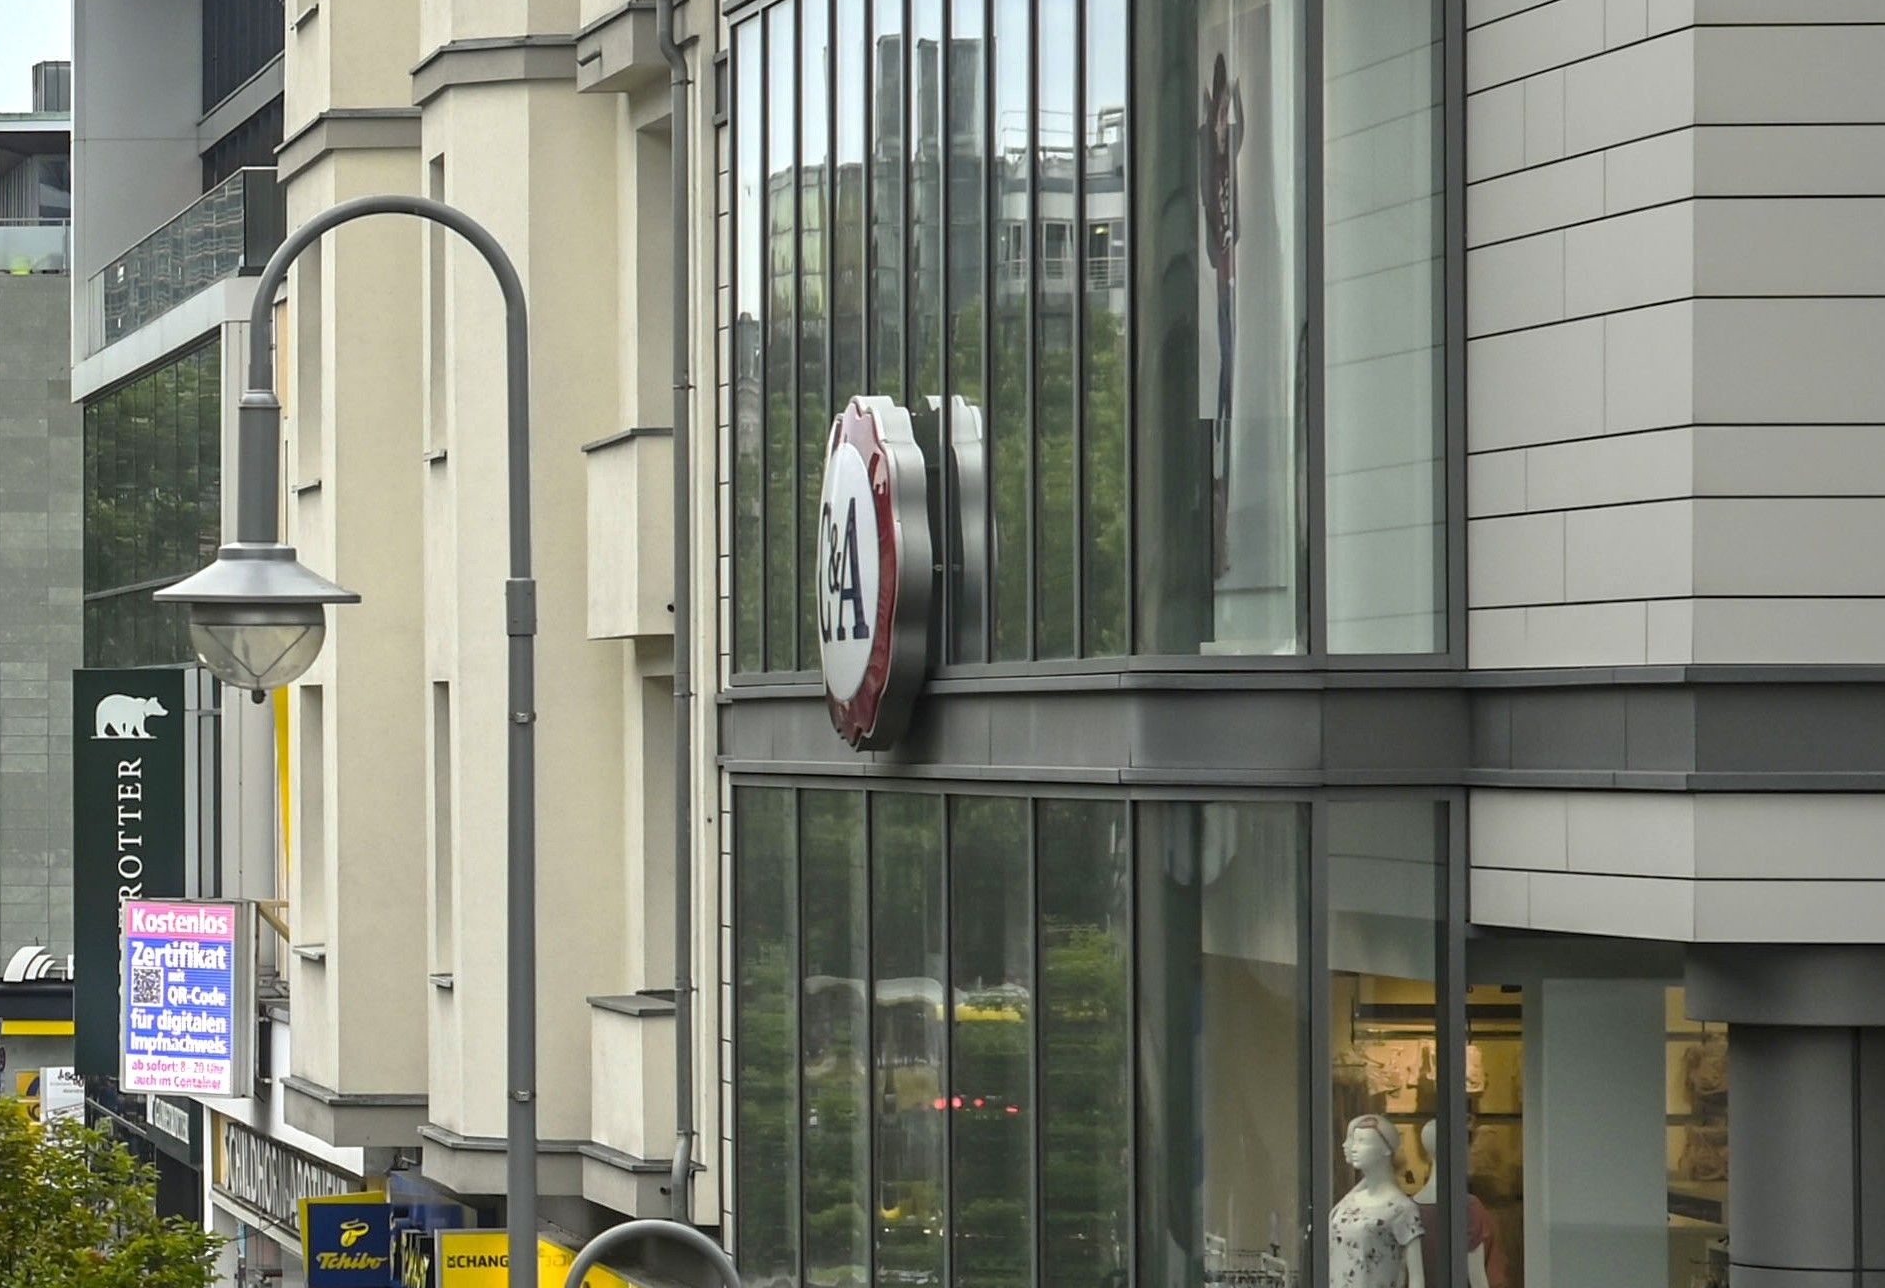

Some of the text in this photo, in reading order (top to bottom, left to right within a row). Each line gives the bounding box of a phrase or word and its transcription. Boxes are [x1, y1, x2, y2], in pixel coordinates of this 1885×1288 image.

[820, 497, 870, 643] C&A
[117, 757, 143, 905] ROTTER
[131, 908, 228, 935] Kostenlos
[132, 941, 226, 969] Zertifikat
[167, 986, 226, 1007] QR-Code
[130, 1009, 226, 1035] für digitalen
[130, 1032, 228, 1055] Impfnachweis
[132, 1059, 144, 1070] ab
[134, 1075, 157, 1087] auch
[174, 1076, 221, 1090] Container
[316, 1252, 388, 1270] Tchibo
